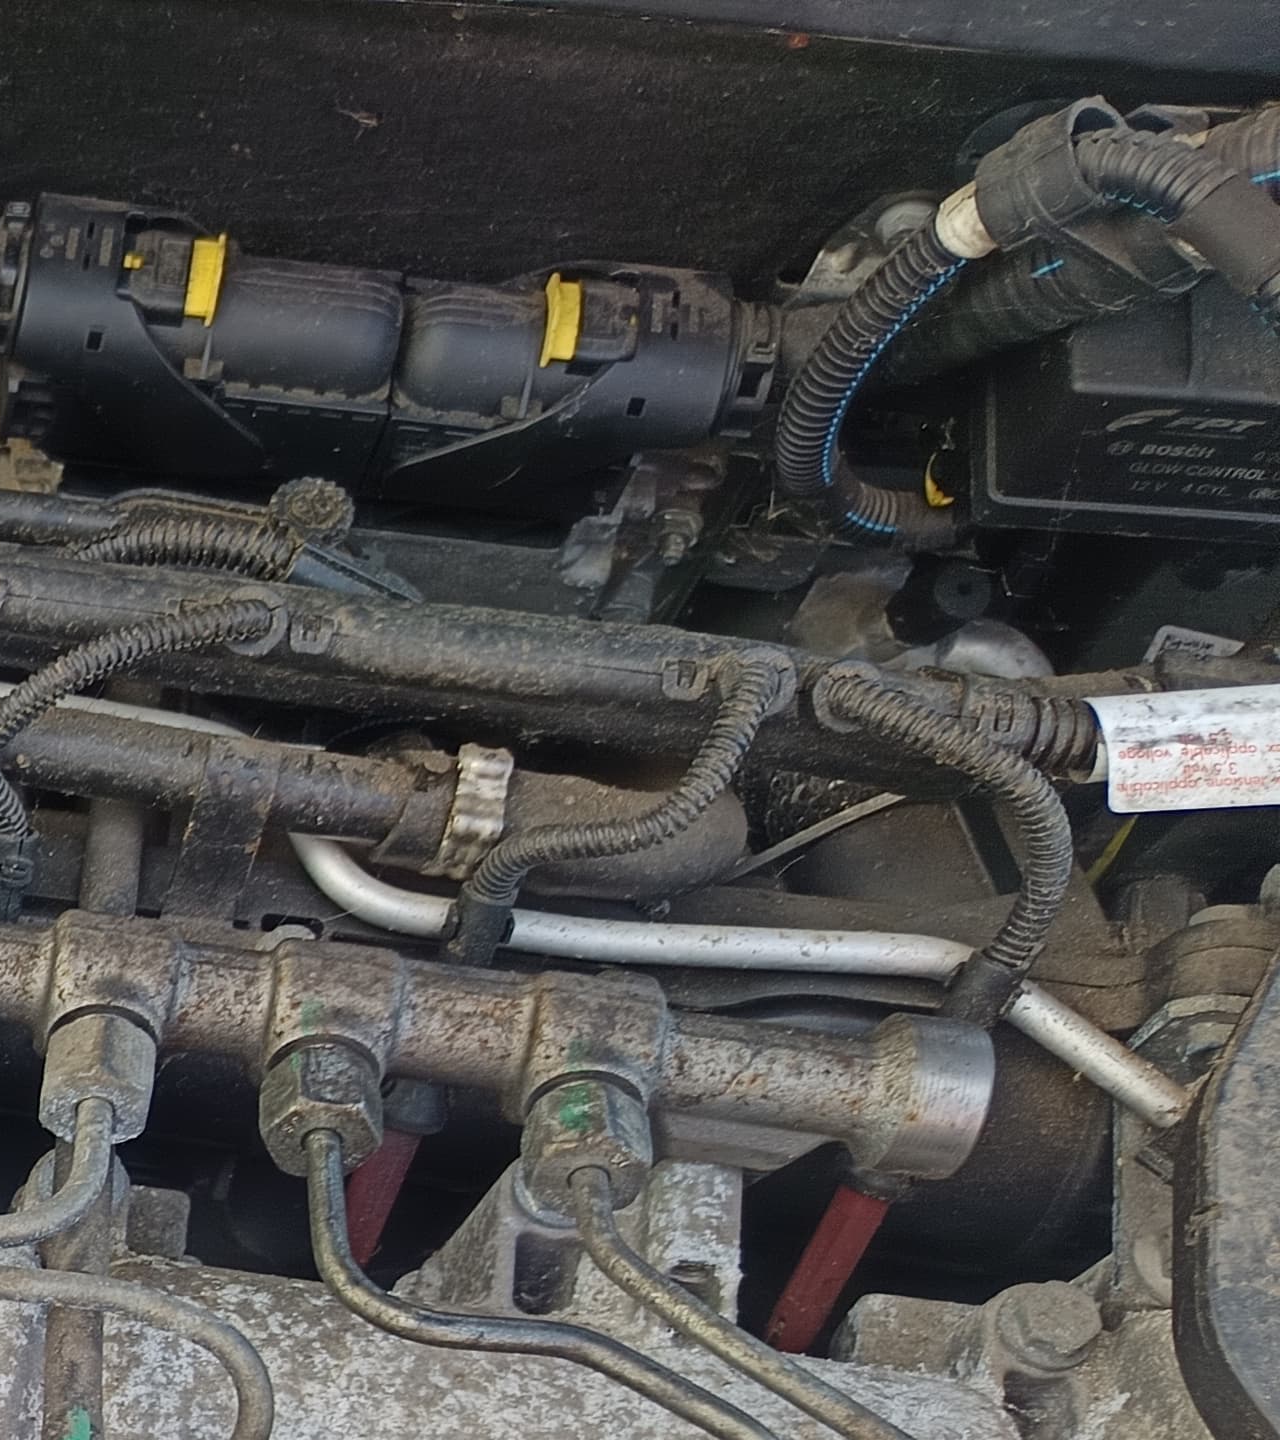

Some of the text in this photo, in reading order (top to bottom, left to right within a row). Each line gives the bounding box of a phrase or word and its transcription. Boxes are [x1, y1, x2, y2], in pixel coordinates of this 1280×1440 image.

[1139, 443, 1216, 458] BOSCH
[1129, 462, 1185, 475] GLOW
[1185, 465, 1266, 480] CONTROL
